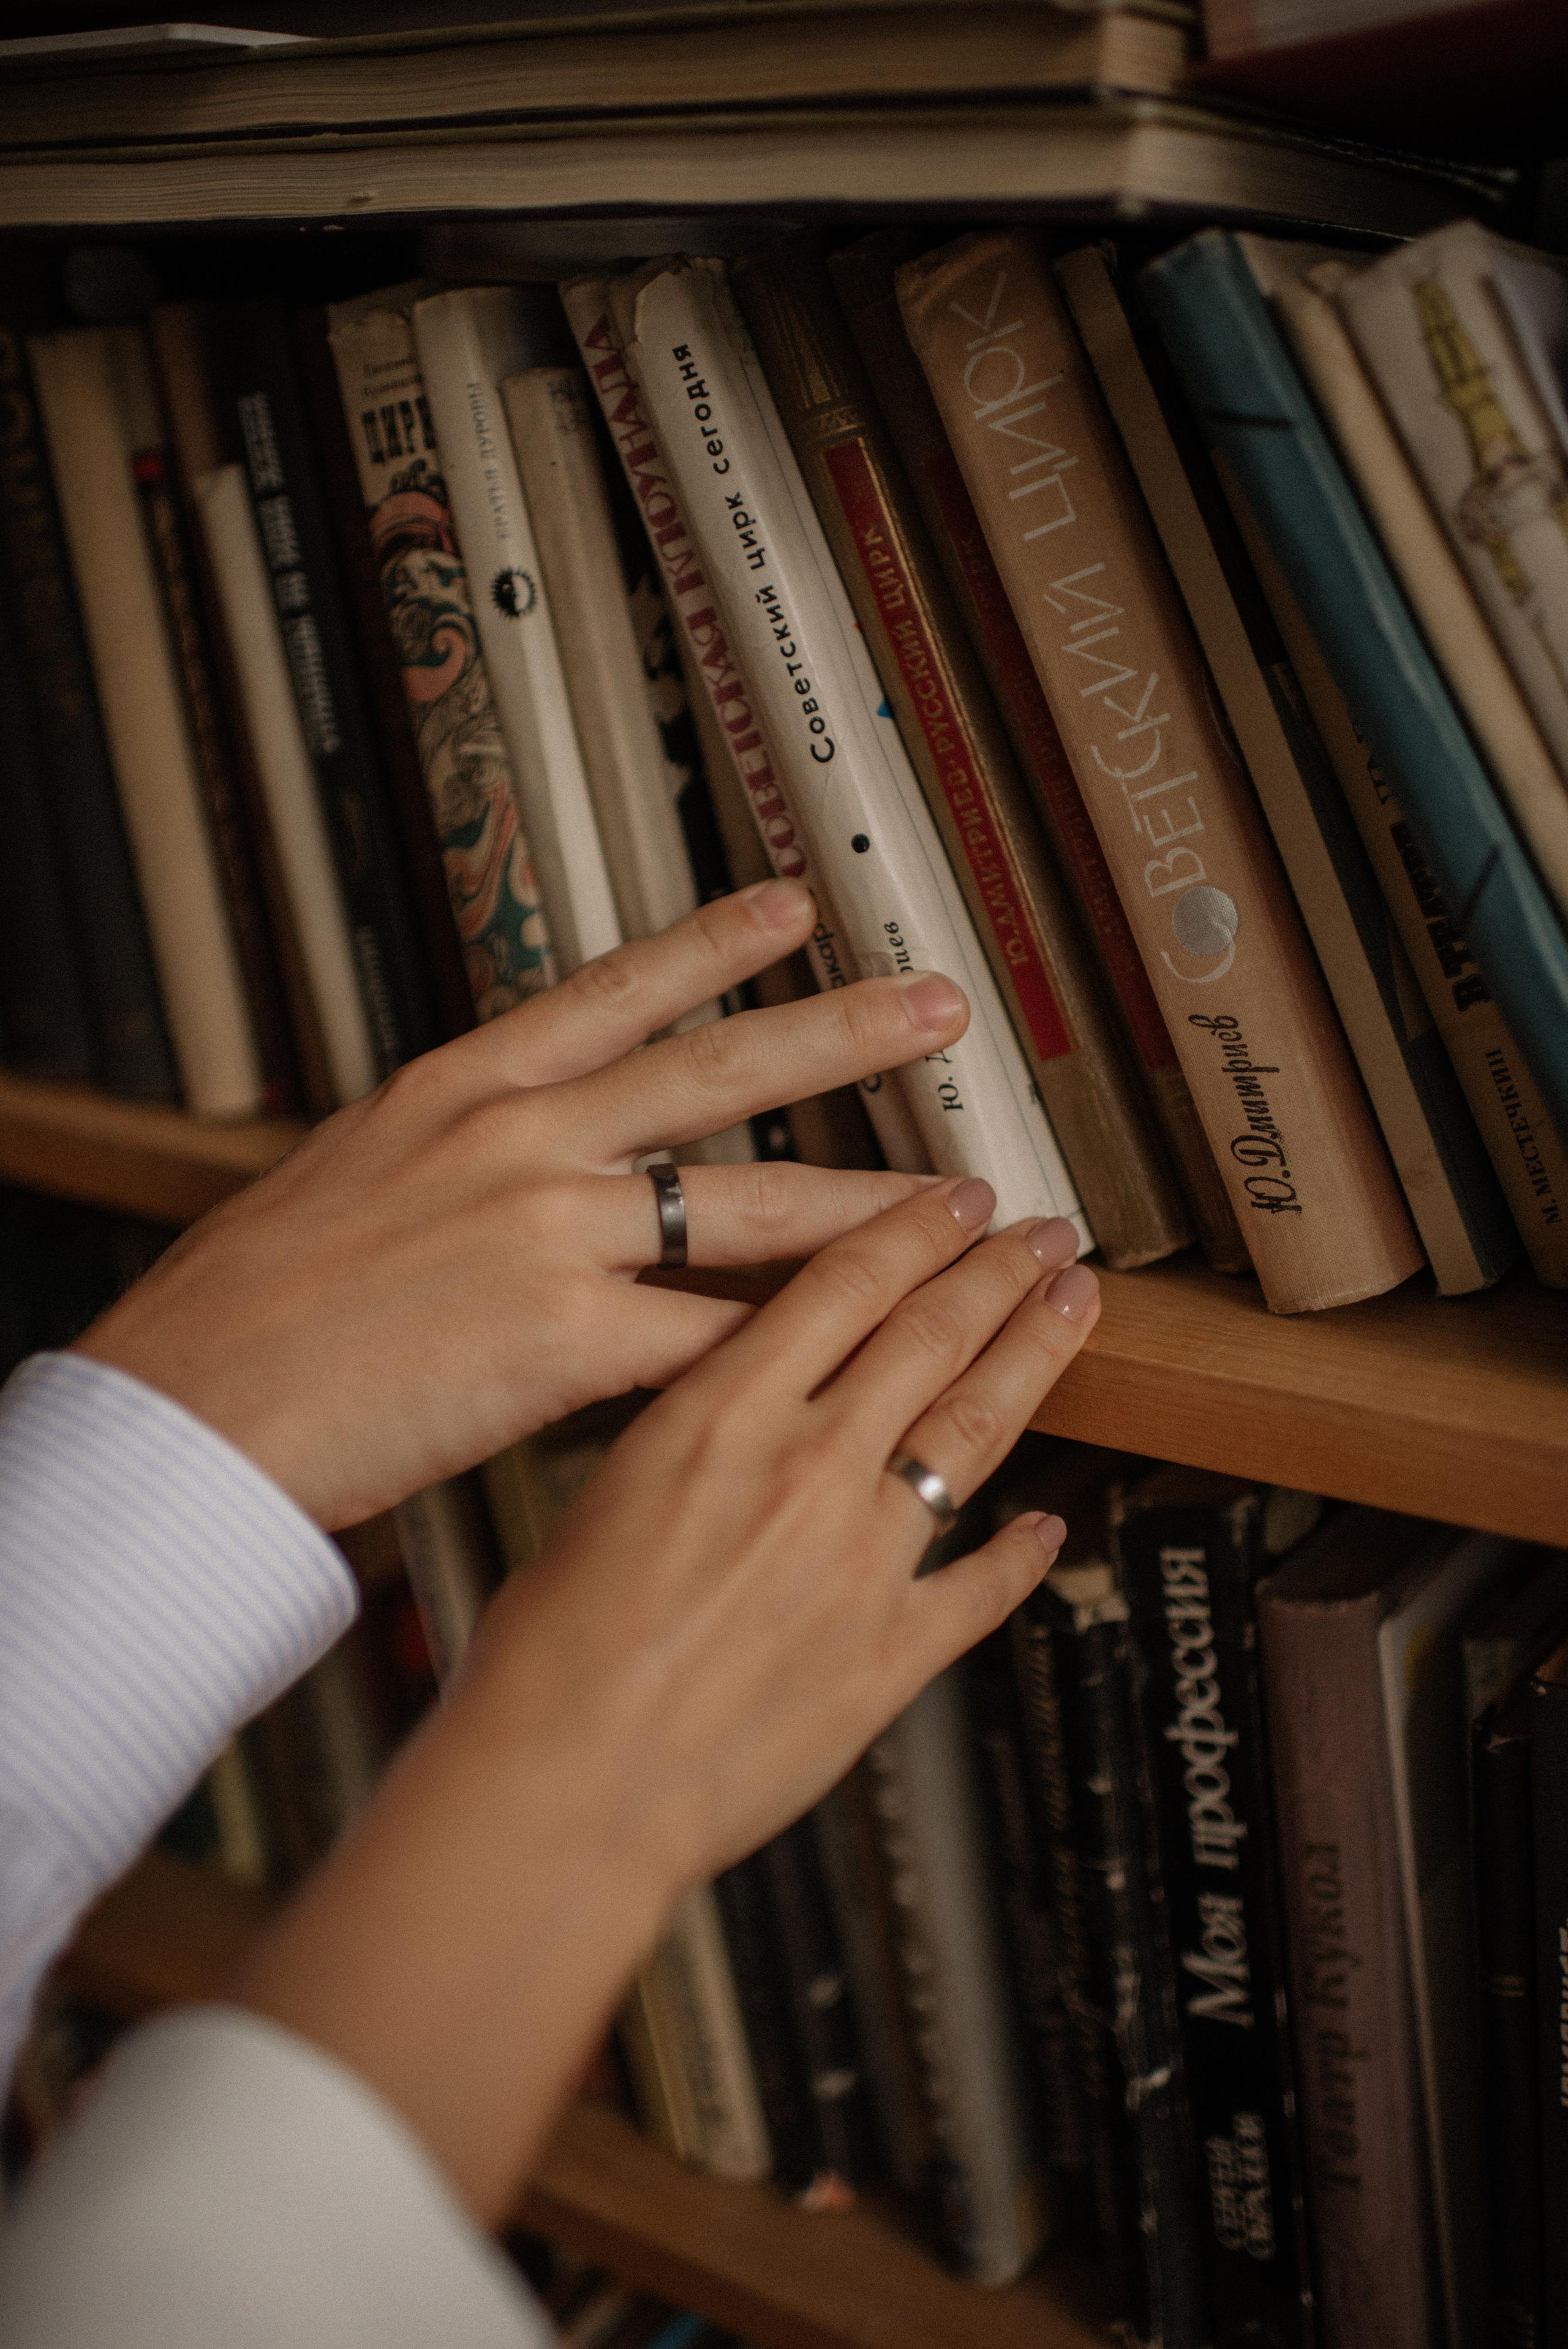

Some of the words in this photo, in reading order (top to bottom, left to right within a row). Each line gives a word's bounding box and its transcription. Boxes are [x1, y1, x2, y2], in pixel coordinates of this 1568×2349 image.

[582, 312, 704, 595] КЛОУНАДА
[670, 342, 731, 477] сегодня
[951, 271, 1078, 539] ЦИРК
[725, 492, 765, 570] цирк
[858, 521, 910, 611] ЦИРК
[684, 605, 810, 882] СОВЕТСКАЯ
[755, 584, 837, 765] Советский
[1484, 1048, 1552, 1198] МЕСТЕЧКИН
[1158, 1545, 1248, 1870] профессия
[1182, 1891, 1256, 2029] Моя
